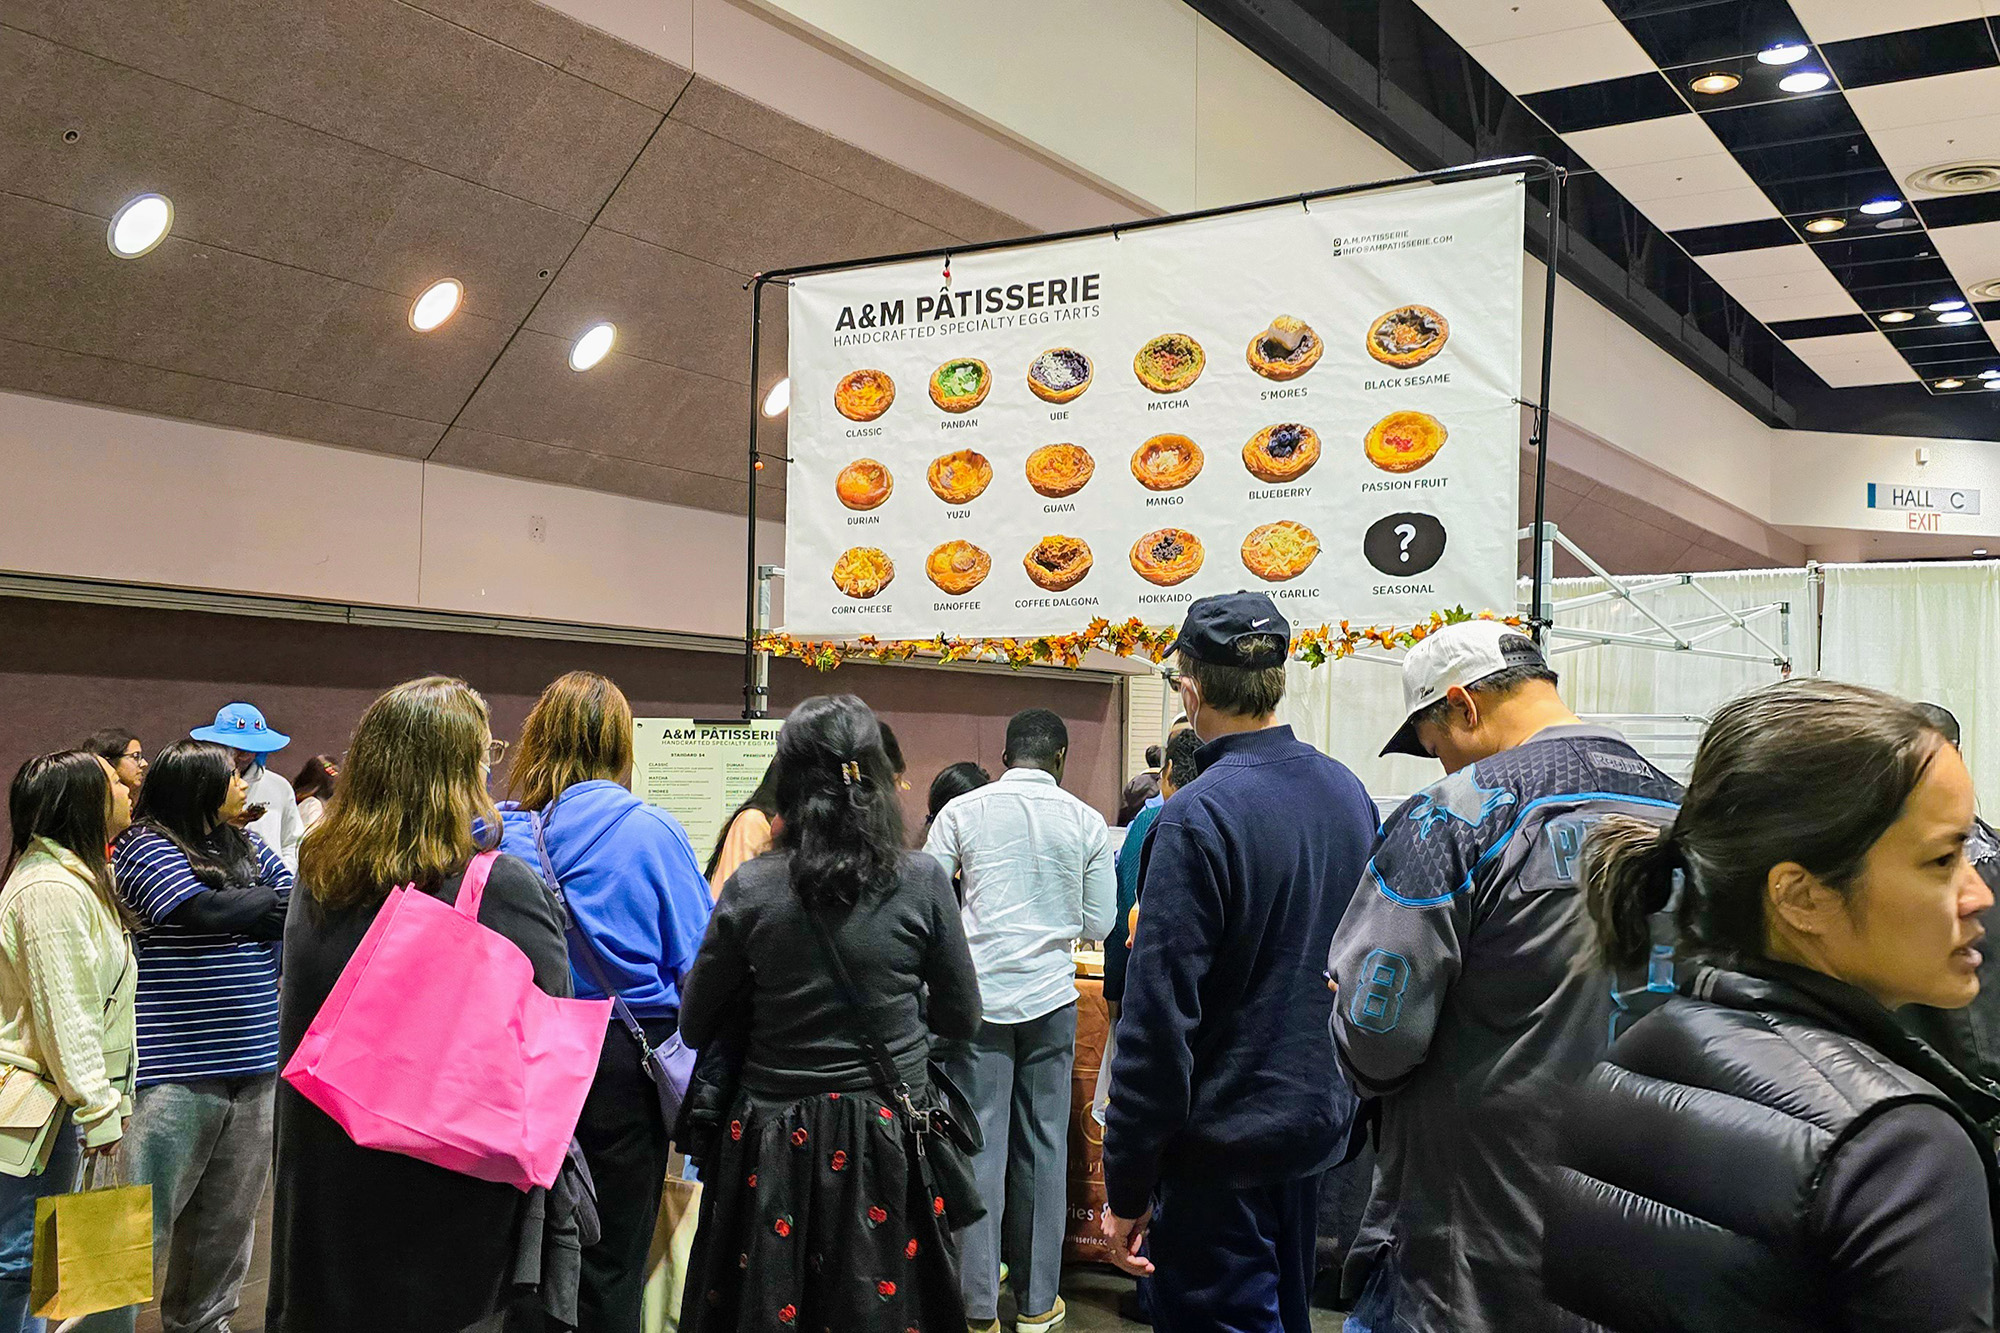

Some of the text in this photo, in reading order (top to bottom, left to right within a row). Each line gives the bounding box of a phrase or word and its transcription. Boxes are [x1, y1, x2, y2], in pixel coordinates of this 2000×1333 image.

[1343, 235, 1453, 256] INFO@AMPATISSERIE.COM
[834, 273, 1100, 331] A&M PÂTISSERIE
[834, 305, 1100, 347] HANDCRAFTED SPECIALTY EGG TARTS
[1364, 373, 1450, 391] BLACK SESAME
[1260, 388, 1308, 401] S'MORES
[1147, 399, 1190, 411] MATCHA
[1049, 411, 1069, 421] UBE
[940, 418, 978, 430] PANDAN
[845, 427, 882, 438] CLASSIC
[1361, 477, 1449, 493] PASSION FRUIT
[1248, 487, 1312, 500] BLUEBERRY
[1893, 488, 1965, 509] HALL C
[1146, 496, 1184, 507] MANGO
[946, 510, 971, 520] YUZU
[1043, 504, 1076, 514] GUAVA
[847, 515, 880, 526] DURIAN
[1908, 512, 1941, 531] EXIT
[1279, 588, 1320, 599] GARLIC
[1372, 584, 1435, 596] SEASONAL
[1014, 596, 1099, 609] COFFEE DALGONA
[1138, 593, 1193, 604] HOKKAIDO
[831, 604, 893, 615] CORN CHEESE
[933, 601, 981, 612] BANOFFEE
[662, 729, 696, 740] A&M
[1350, 948, 1411, 1034] 8
